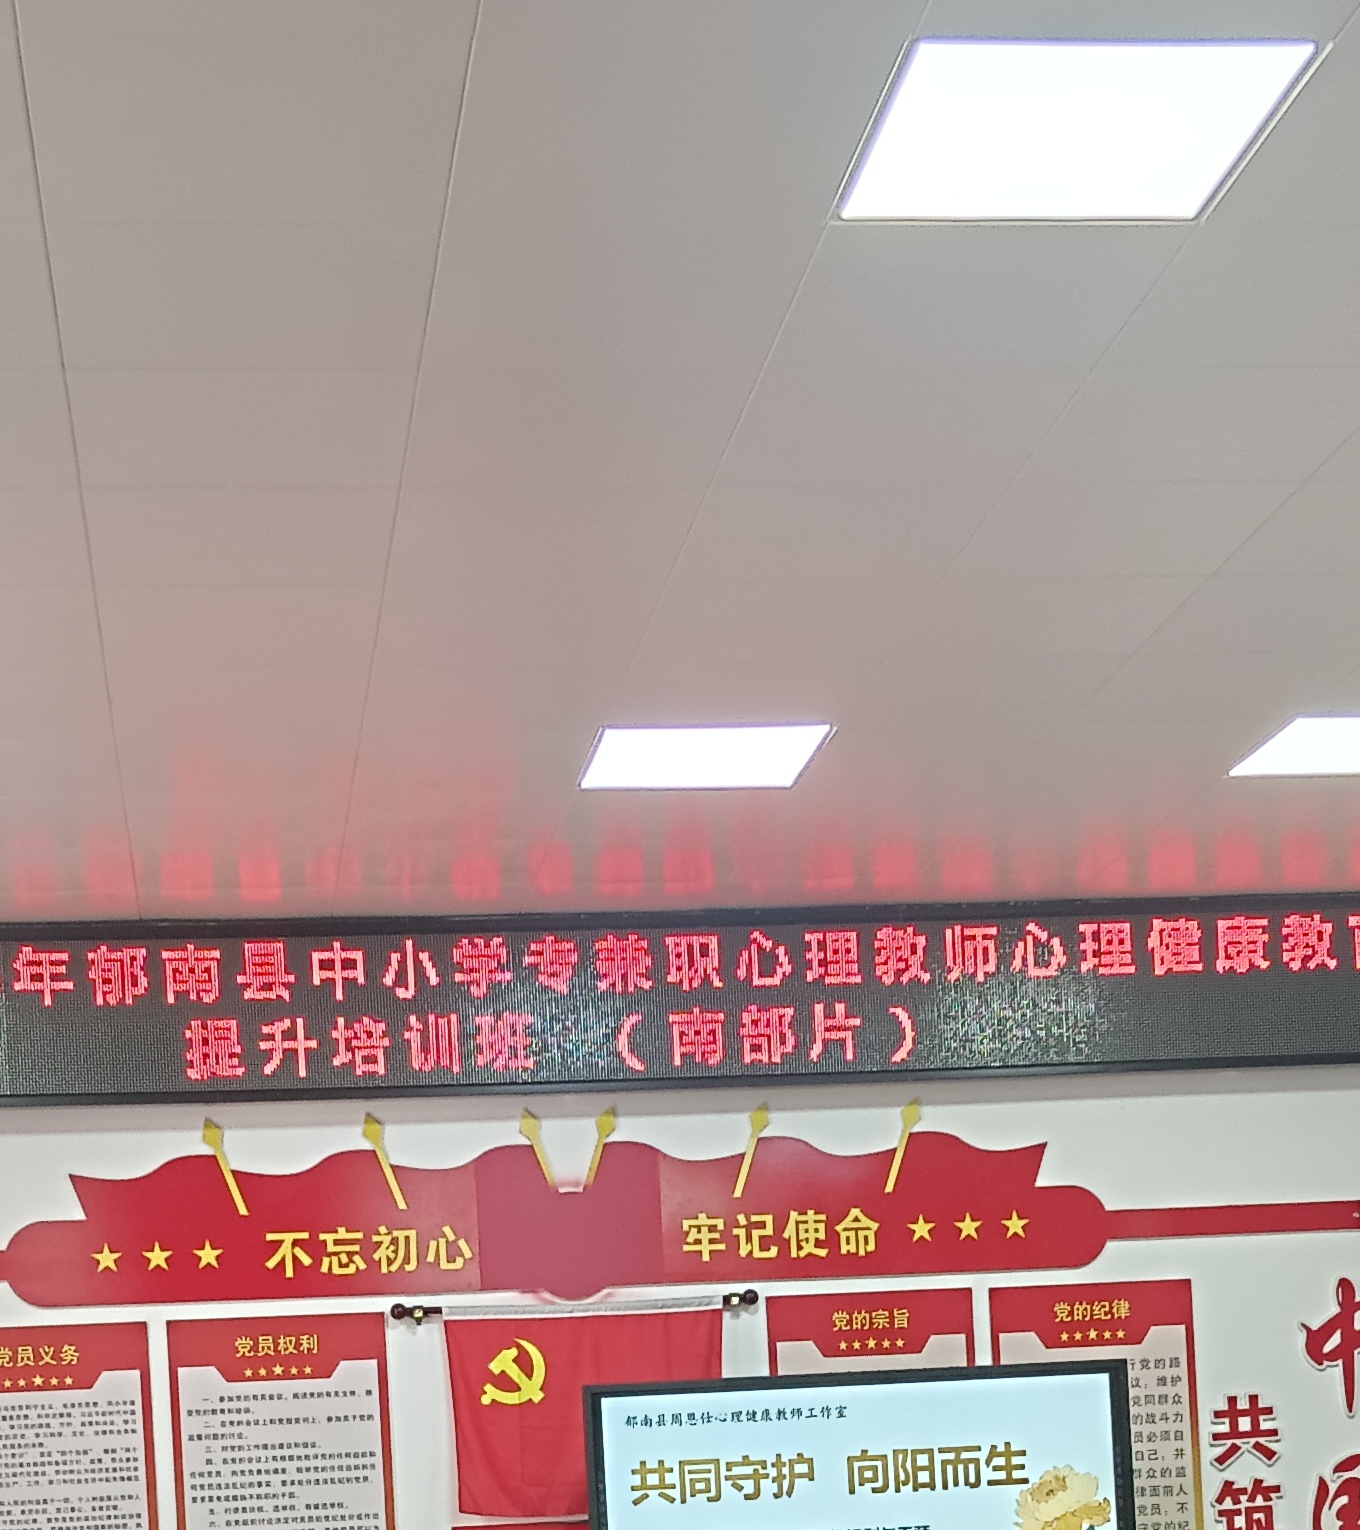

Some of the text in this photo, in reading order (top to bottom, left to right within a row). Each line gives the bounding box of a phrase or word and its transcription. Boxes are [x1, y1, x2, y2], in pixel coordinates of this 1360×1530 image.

[682, 1207, 882, 1263] 牢记使命
[264, 1225, 473, 1278] 不忘初心
[831, 1308, 911, 1332] 党的宗旨
[1052, 1298, 1132, 1323] 党的纪律
[234, 1334, 320, 1358] 党员权利
[1131, 1411, 1184, 1426] 的战斗力
[630, 1441, 1030, 1507] 共同守护 向阳而生
